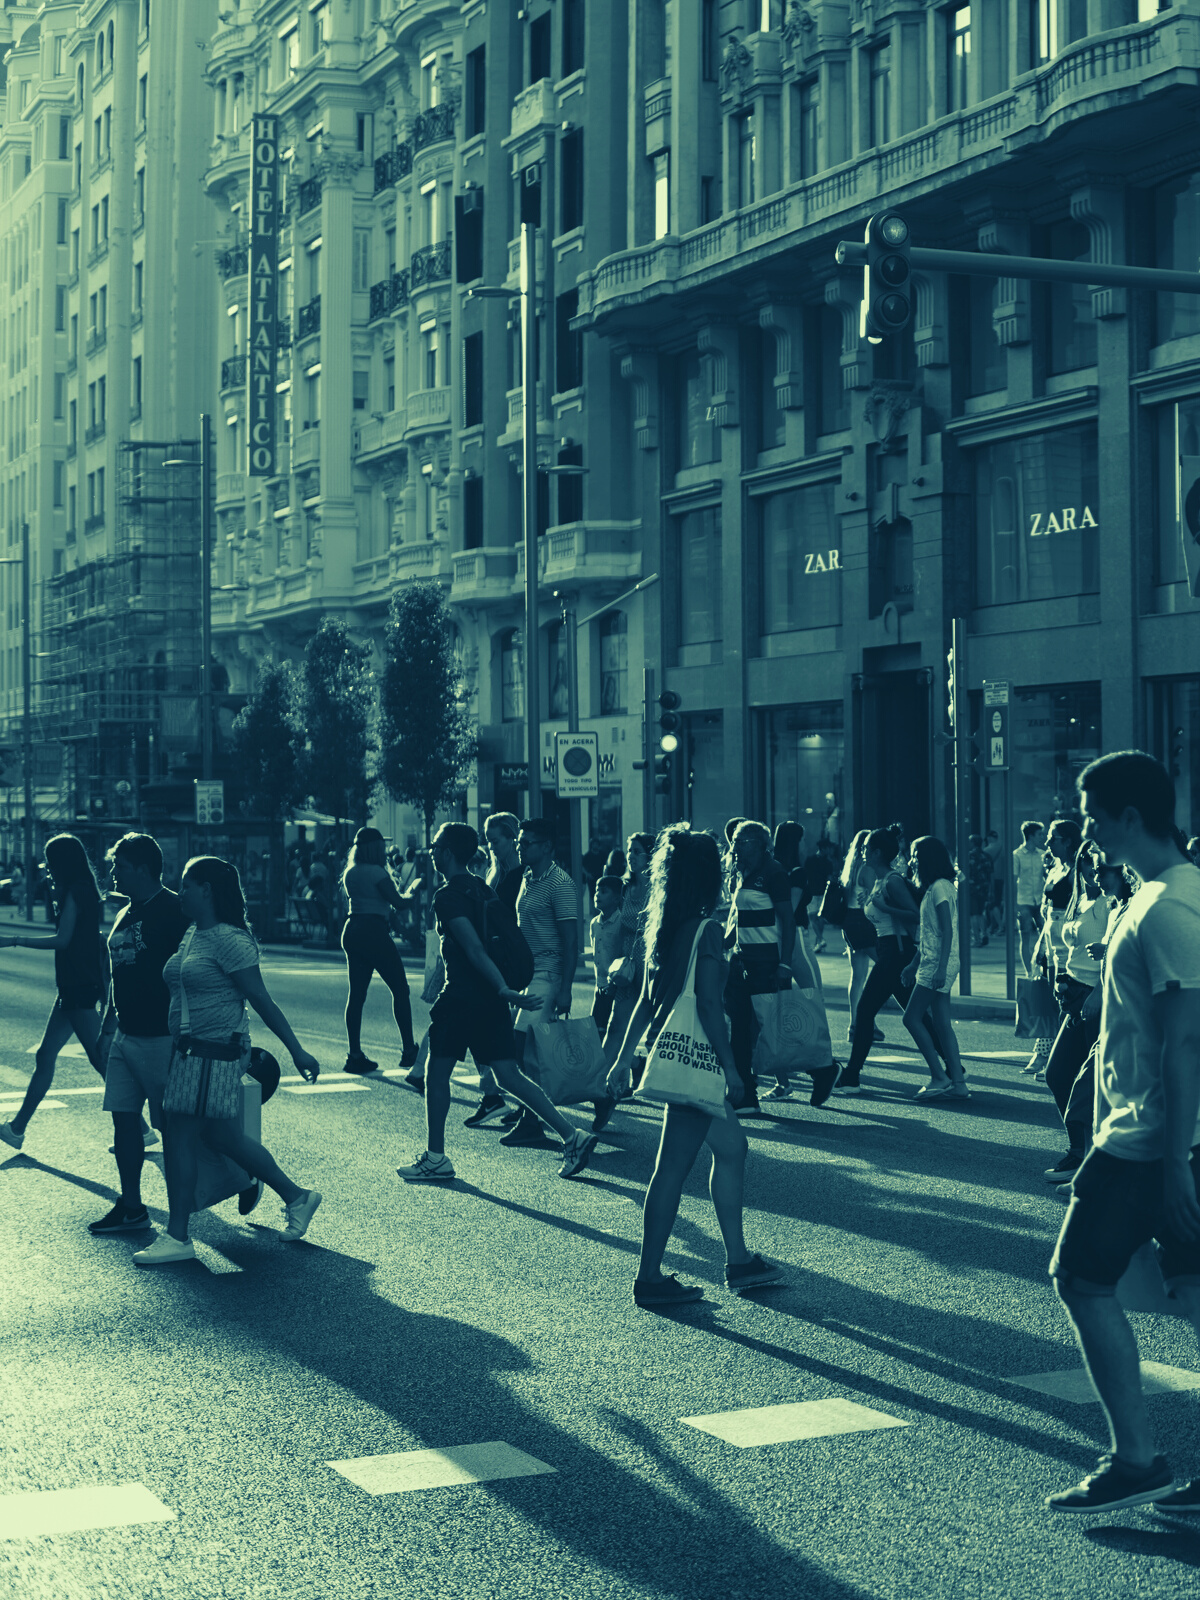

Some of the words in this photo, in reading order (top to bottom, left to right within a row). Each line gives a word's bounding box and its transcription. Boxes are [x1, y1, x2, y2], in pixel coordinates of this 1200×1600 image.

[256, 119, 276, 236] HOTEL
[253, 253, 275, 470] ATLANTICO
[1029, 505, 1099, 538] ZARA
[803, 548, 844, 575] ZAR
[501, 767, 529, 779] NYX
[783, 1014, 803, 1033] 50
[659, 1050, 675, 1060] GO
[678, 1053, 691, 1065] TO
[692, 1059, 722, 1076] WASTE
[697, 1052, 721, 1066] NEVE
